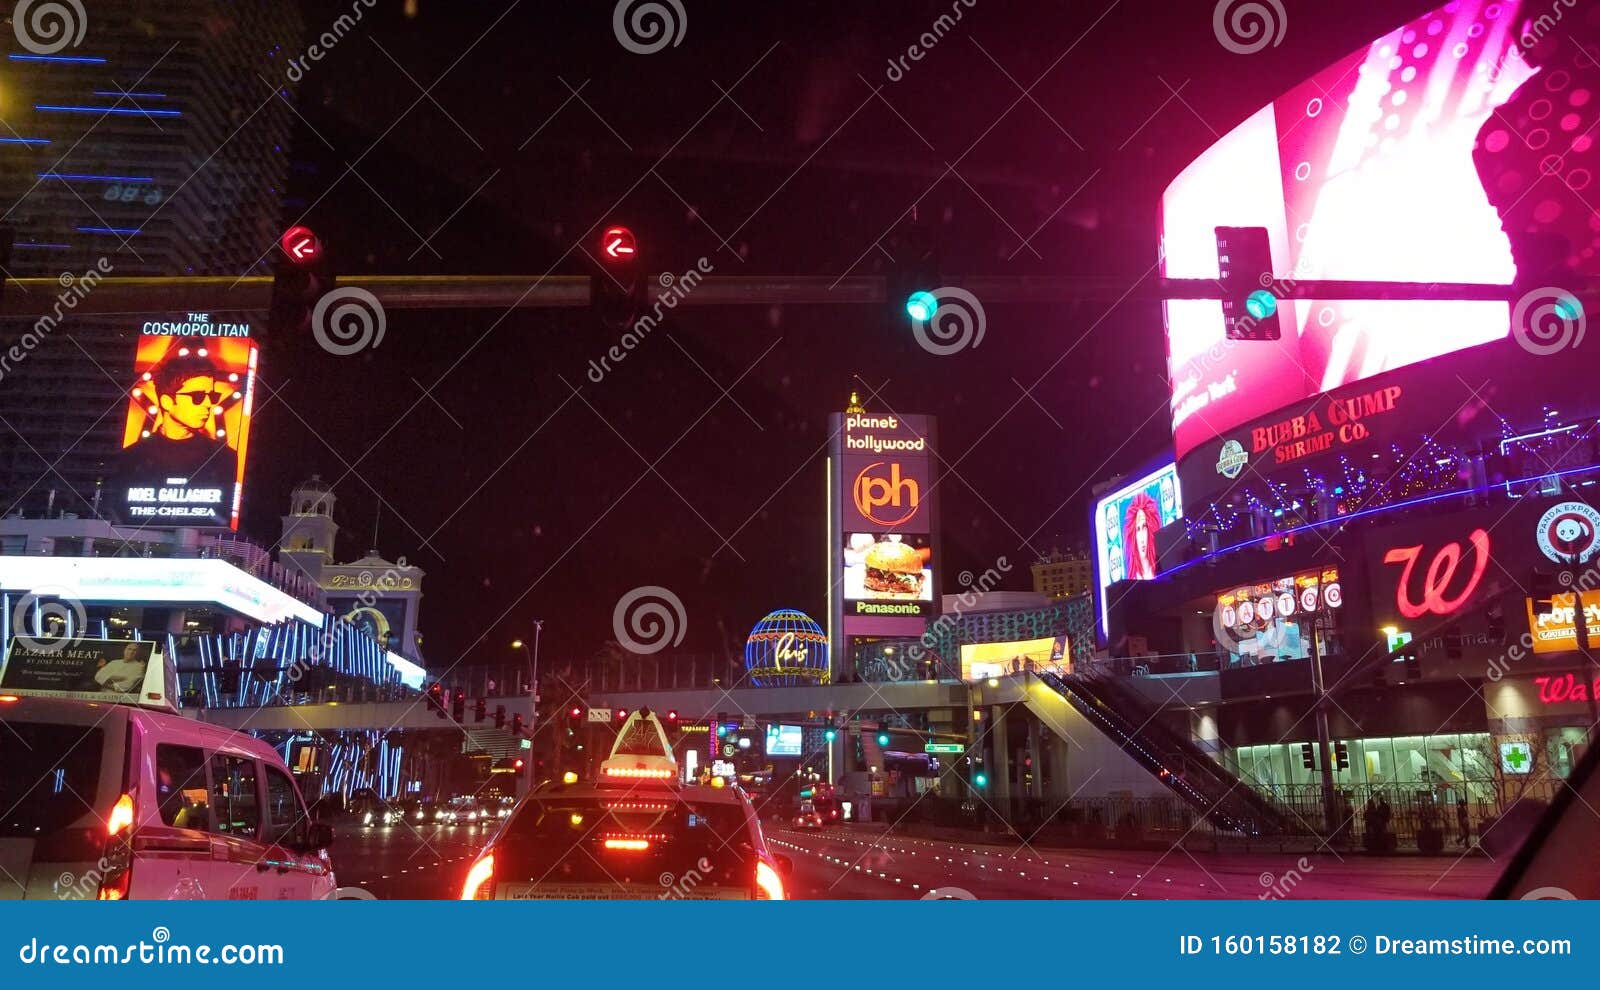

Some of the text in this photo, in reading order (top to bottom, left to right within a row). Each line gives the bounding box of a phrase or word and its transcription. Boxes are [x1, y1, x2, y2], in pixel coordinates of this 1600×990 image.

[187, 313, 209, 322] THE
[143, 322, 249, 337] COSMOPOLITAN
[847, 414, 898, 431] planet
[1251, 385, 1402, 454] BUBBA GUMP
[847, 435, 924, 453] hollywood
[1275, 432, 1335, 464] SHRIMP
[1339, 423, 1370, 443] CO.
[128, 487, 157, 502] NOEL
[861, 463, 919, 515] ph
[1539, 507, 1563, 534] PANDA
[856, 601, 921, 614] Panasonic
[14, 648, 100, 660] BAZAAR MEAT
[775, 632, 808, 671] Paris
